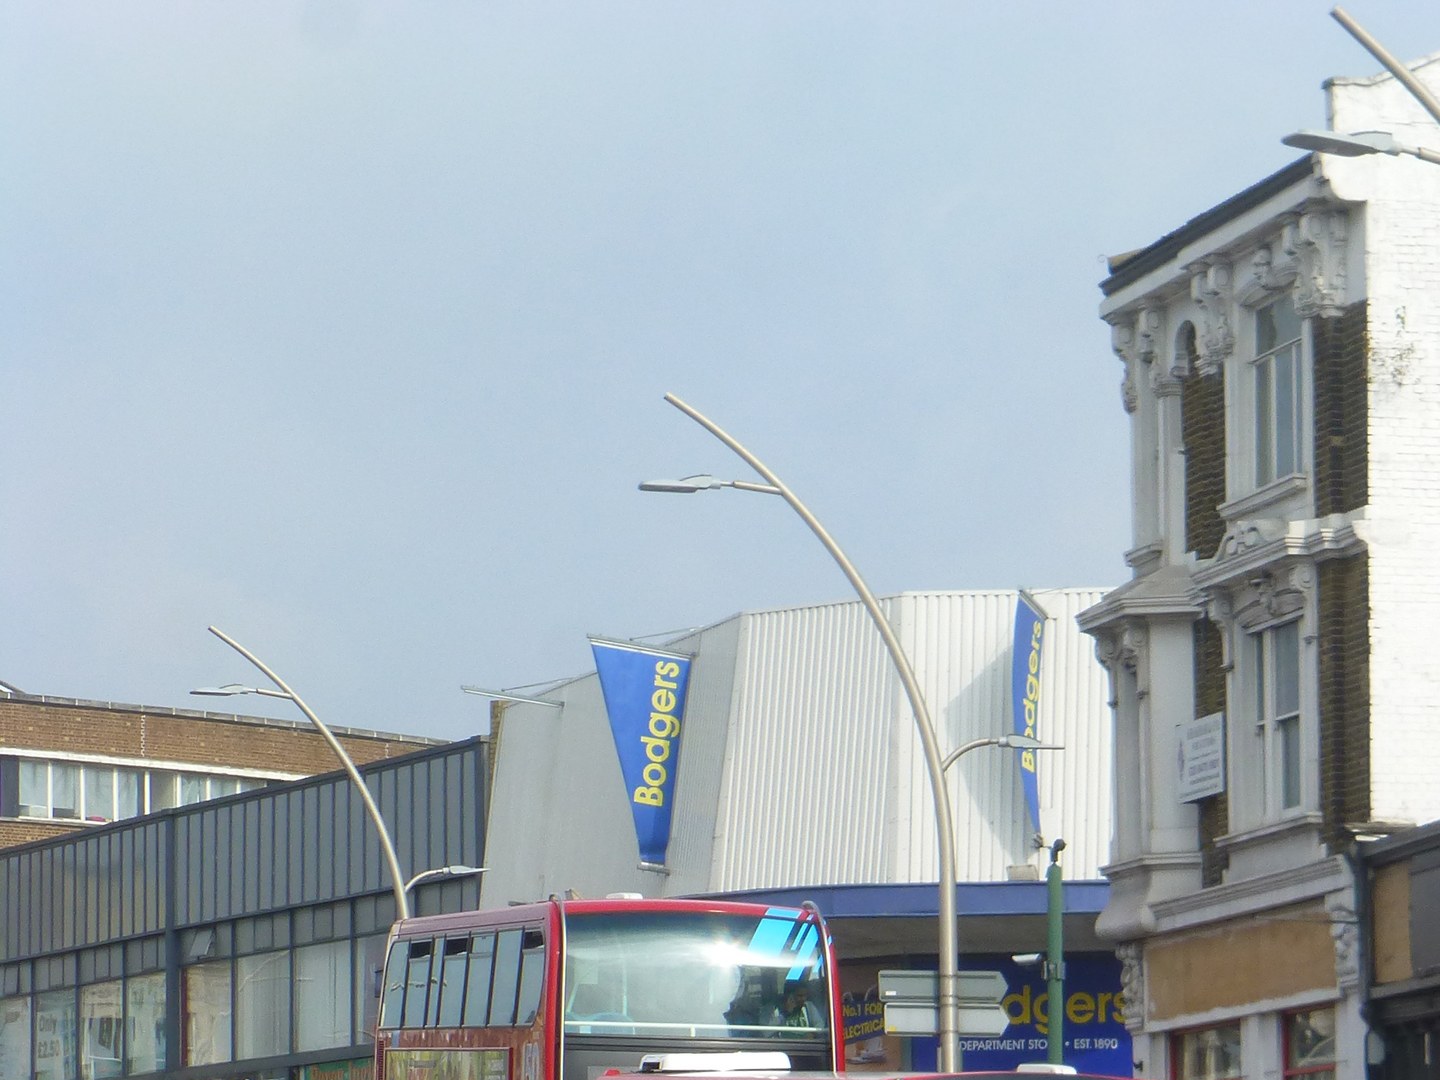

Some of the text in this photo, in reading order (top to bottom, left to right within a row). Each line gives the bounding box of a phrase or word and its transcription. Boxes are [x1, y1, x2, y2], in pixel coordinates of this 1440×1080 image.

[633, 660, 681, 807] Bodgers
[1002, 985, 1126, 1034] dgers
[959, 1038, 1026, 1051] DEPARTMENT
[1028, 1038, 1048, 1050] STO
[1093, 1037, 1119, 1050] 1890
